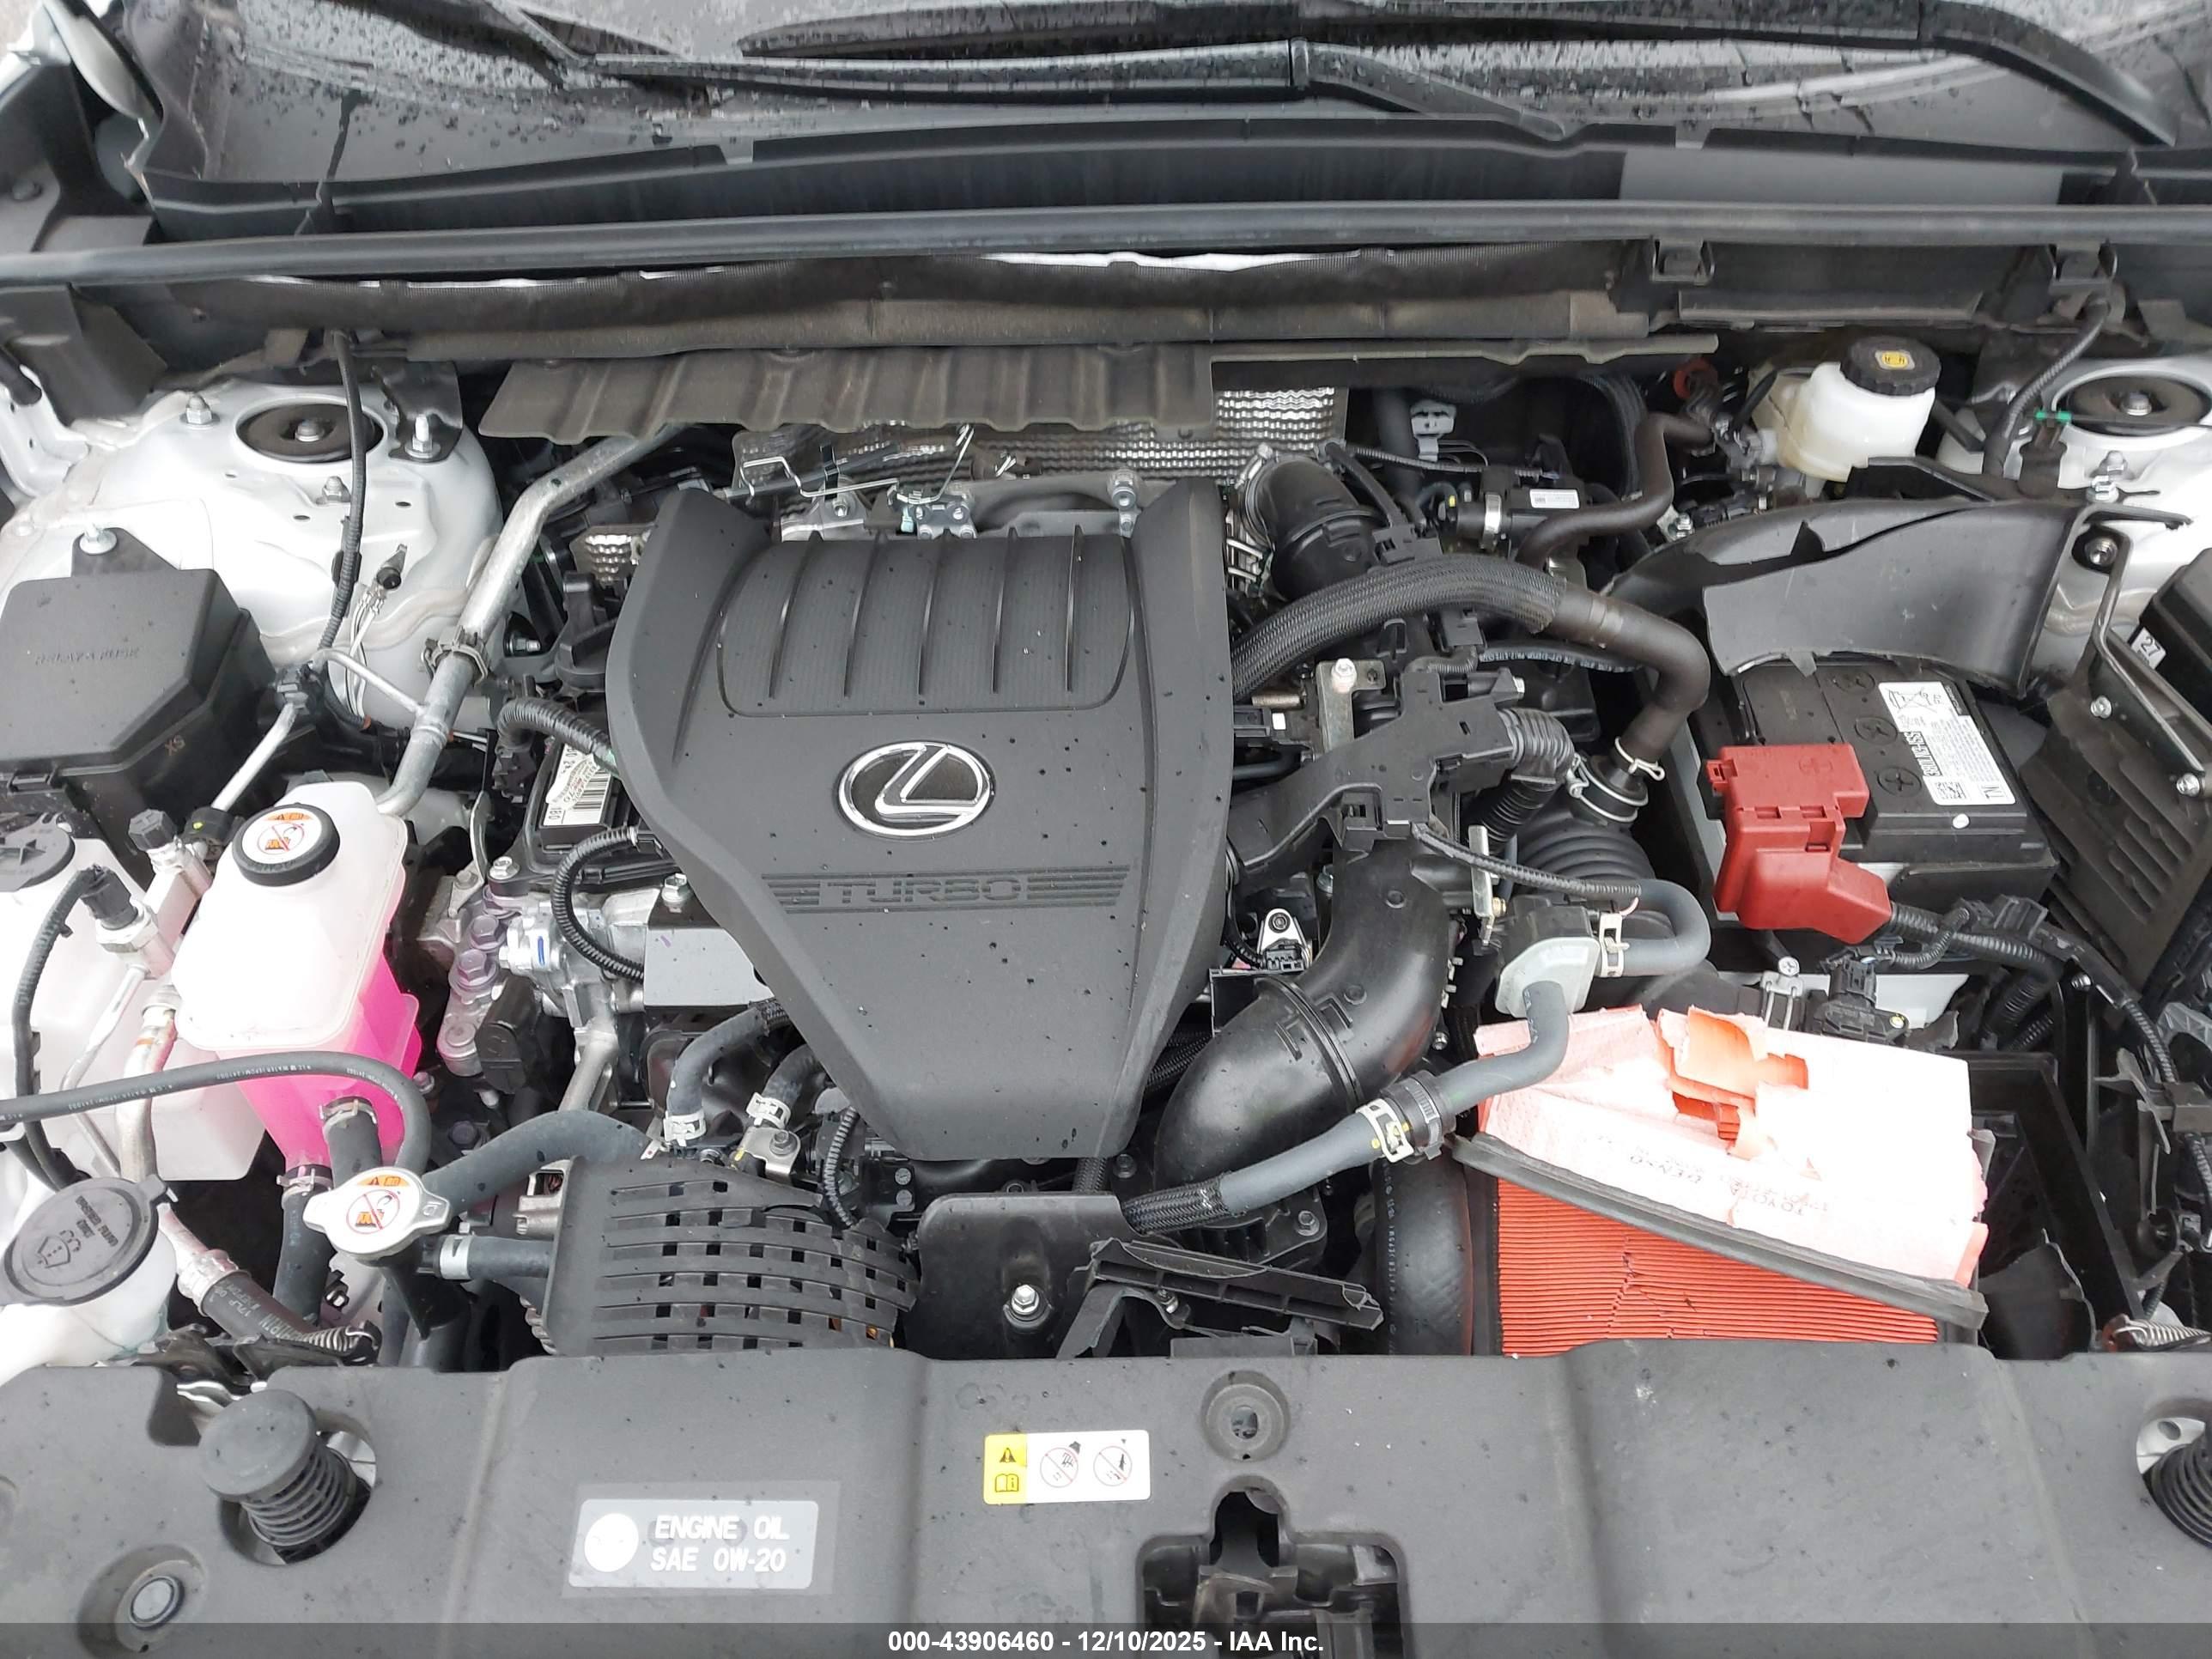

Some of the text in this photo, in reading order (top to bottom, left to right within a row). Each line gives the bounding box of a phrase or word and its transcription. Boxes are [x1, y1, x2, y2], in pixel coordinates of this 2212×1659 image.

[2141, 636, 2160, 656] 27
[827, 878, 1022, 903] TURBO
[654, 1516, 790, 1540] ENGINE OIL
[651, 1547, 787, 1572] SAE 0W-20
